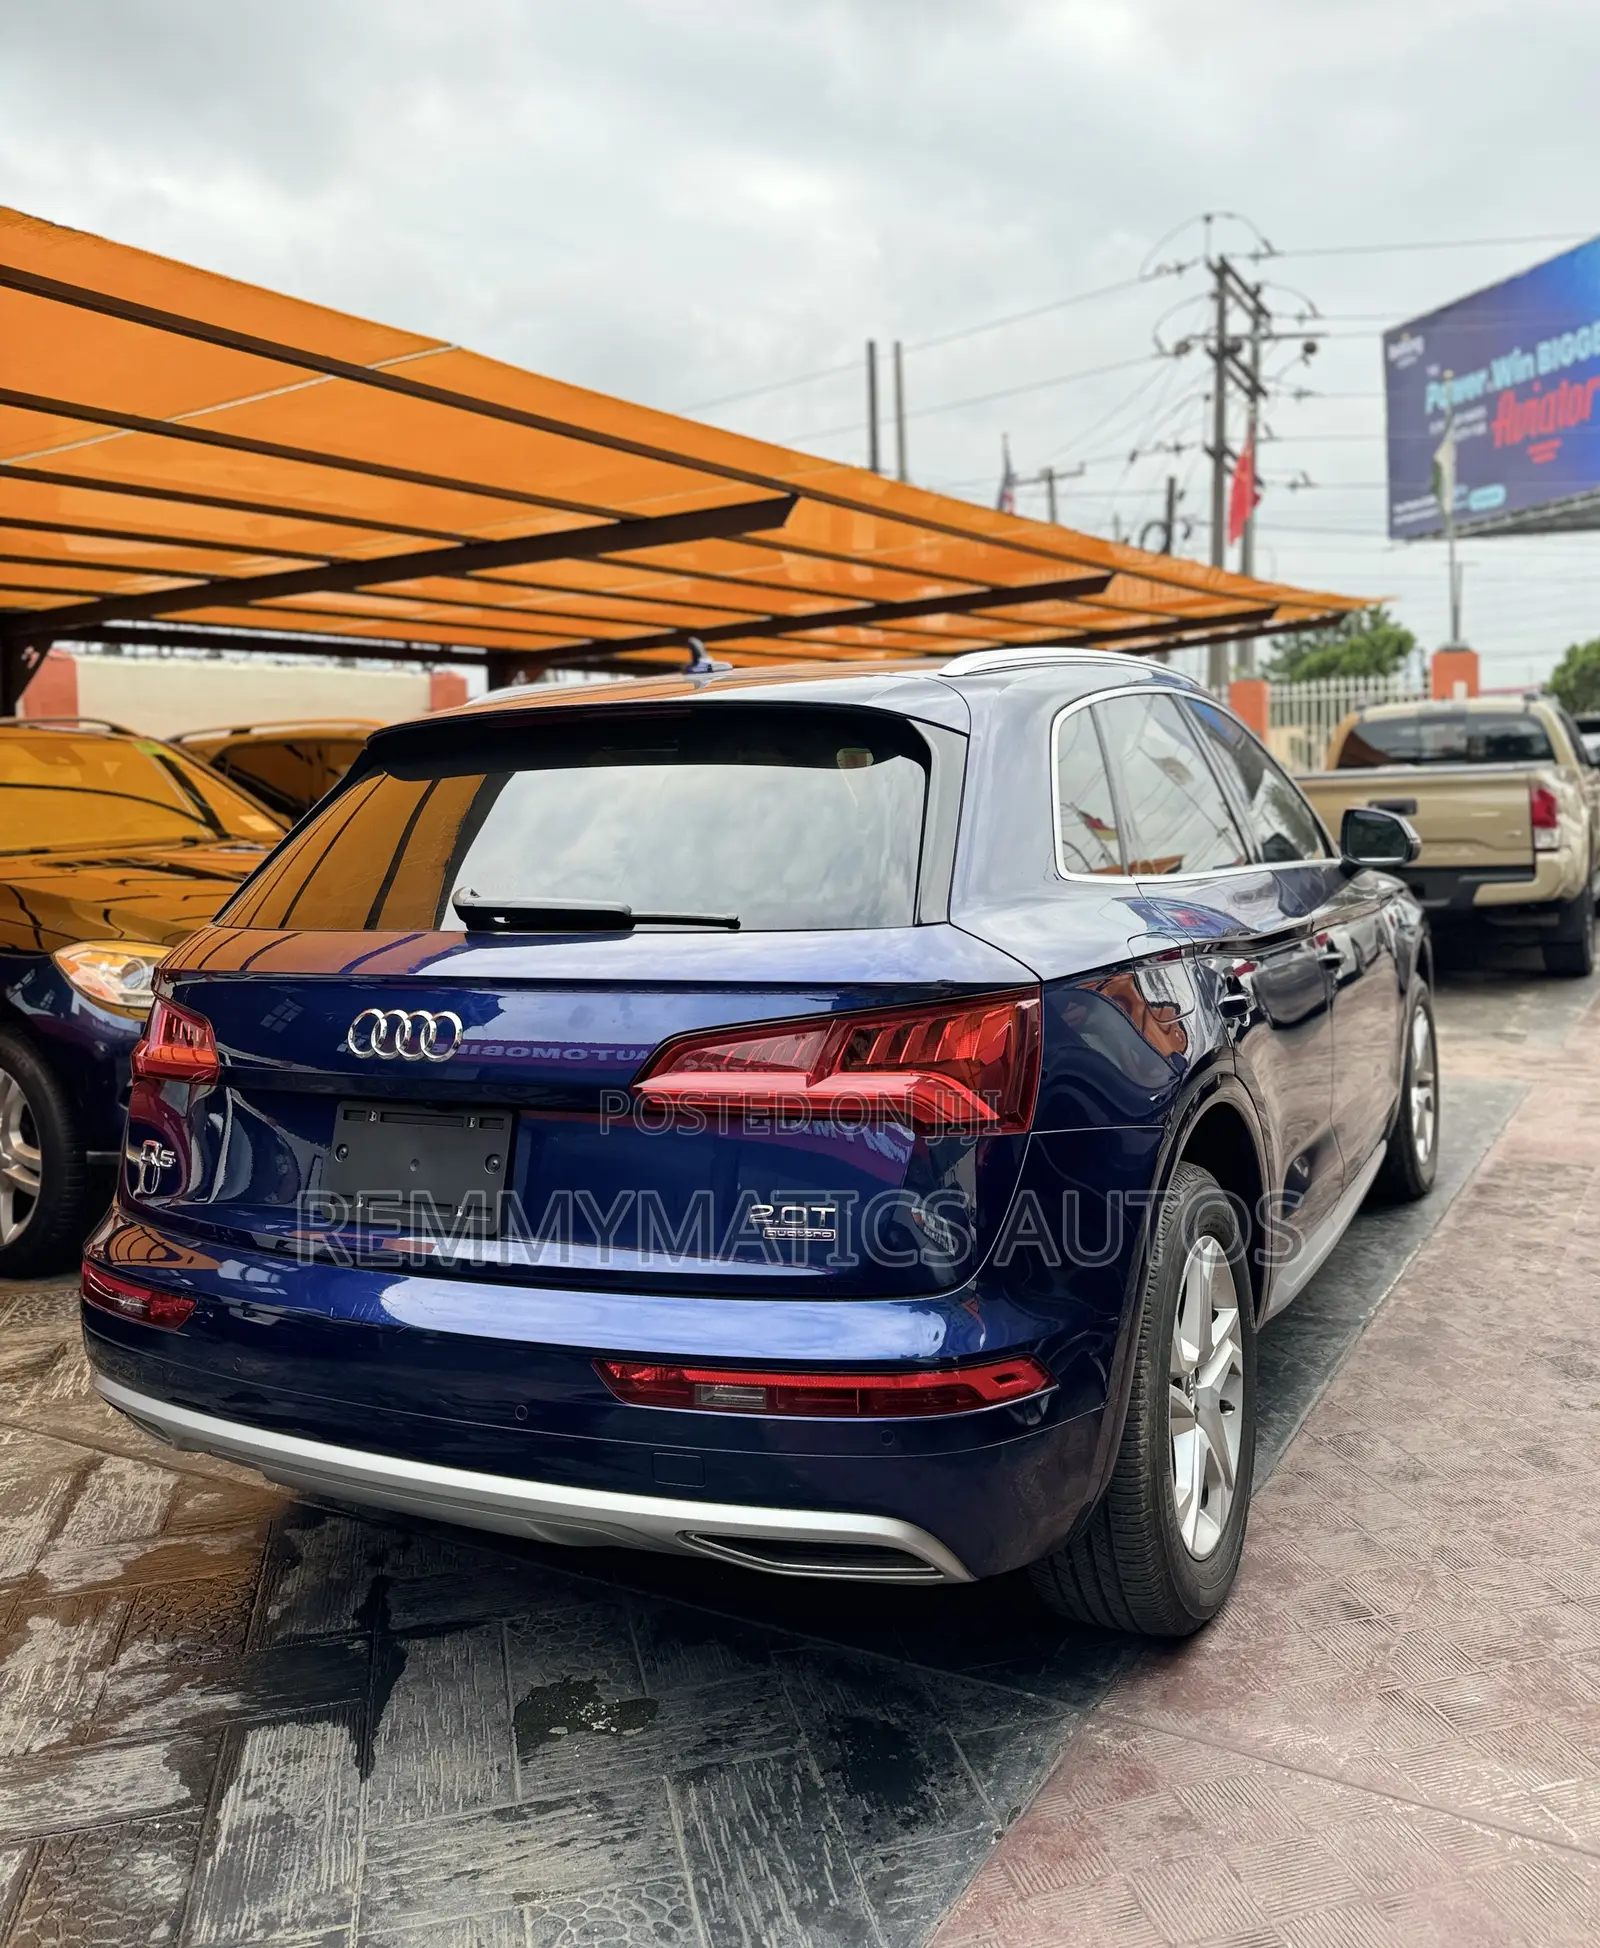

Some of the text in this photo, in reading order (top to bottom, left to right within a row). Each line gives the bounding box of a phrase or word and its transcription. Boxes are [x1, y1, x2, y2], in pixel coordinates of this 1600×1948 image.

[1491, 376, 1600, 448] Aviator
[140, 1139, 176, 1168] Q5
[749, 1204, 836, 1227] 2.0T
[765, 1229, 833, 1239] quattro
